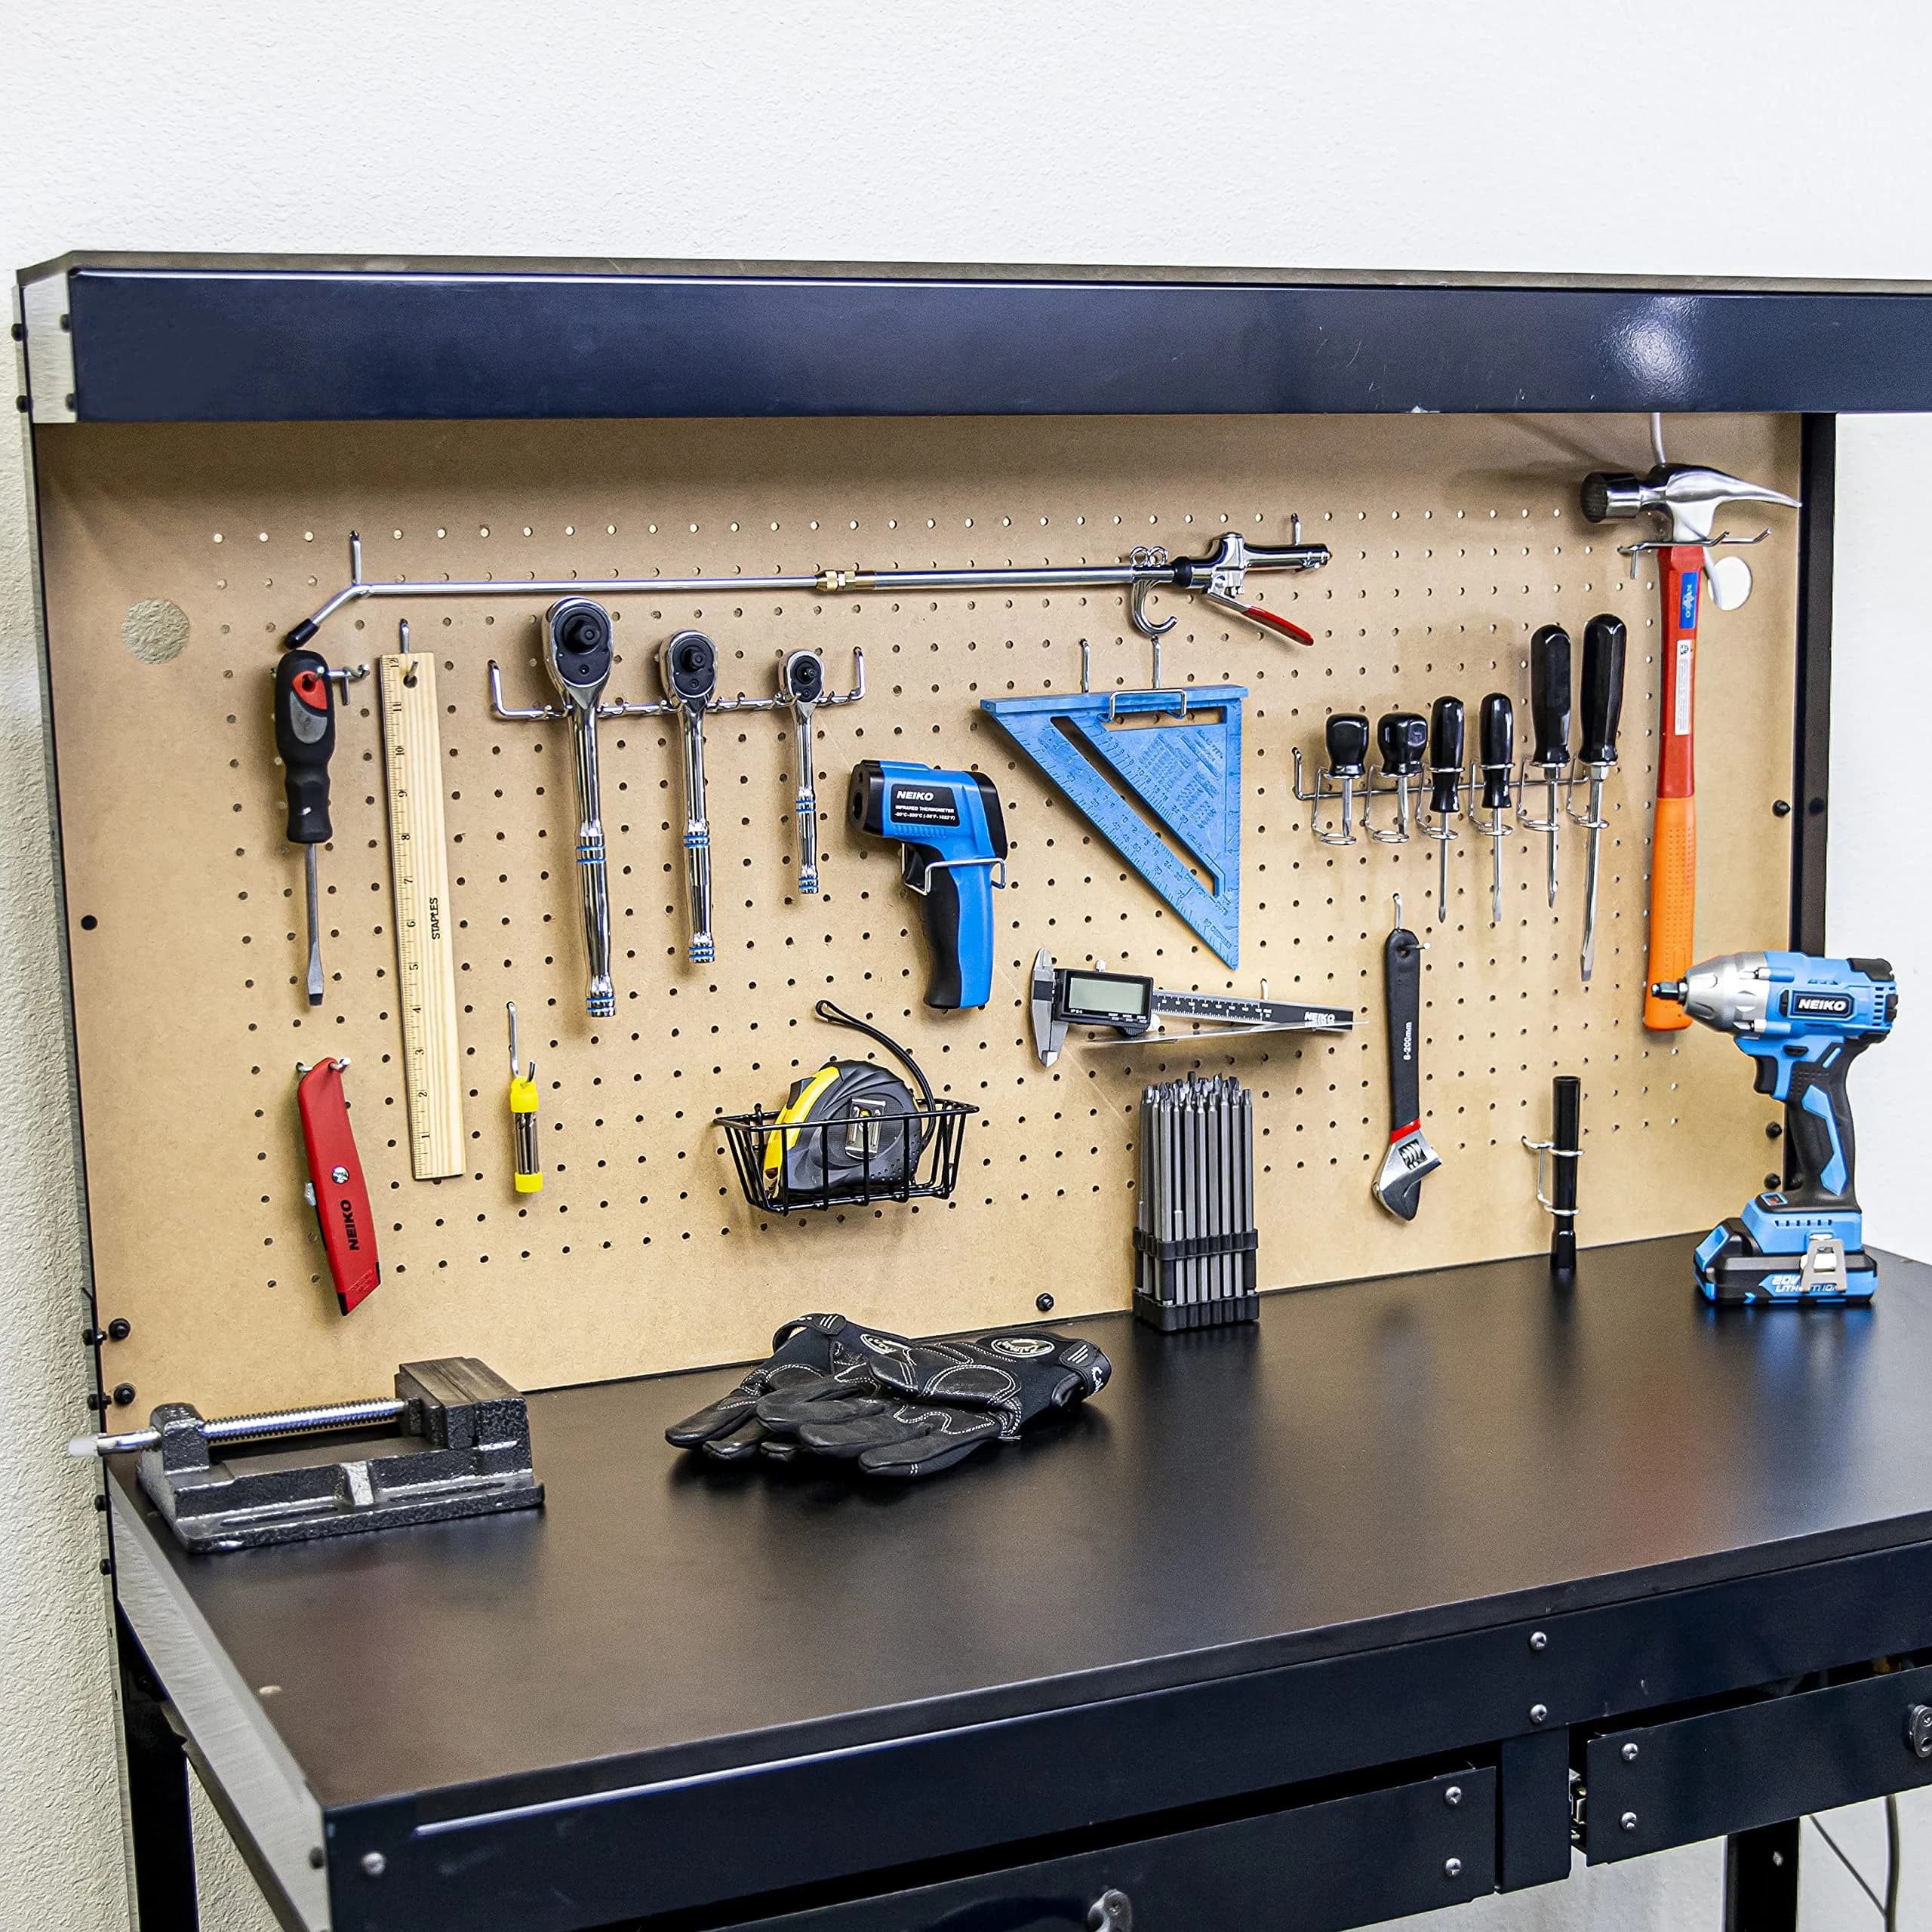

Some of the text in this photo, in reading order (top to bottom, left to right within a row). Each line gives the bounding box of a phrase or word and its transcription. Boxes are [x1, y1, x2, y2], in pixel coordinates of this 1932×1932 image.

[389, 658, 399, 668] 12
[392, 702, 402, 713] 11
[395, 746, 405, 756] 10
[398, 789, 408, 798] 9
[897, 790, 934, 801] NEIKO
[1112, 821, 1121, 831] 40
[401, 833, 411, 841] 8
[404, 876, 414, 884] 7
[429, 897, 441, 940] STAPLES
[406, 920, 416, 928] 6
[409, 963, 419, 971] 5
[412, 1004, 421, 1013] 4
[1798, 998, 1846, 1011] NEIKO
[1304, 1011, 1335, 1023] NEIKO
[415, 1048, 425, 1056] 3
[418, 1090, 428, 1098] 2
[340, 1199, 360, 1251] NEIKO
[1771, 1275, 1801, 1285] 20V
